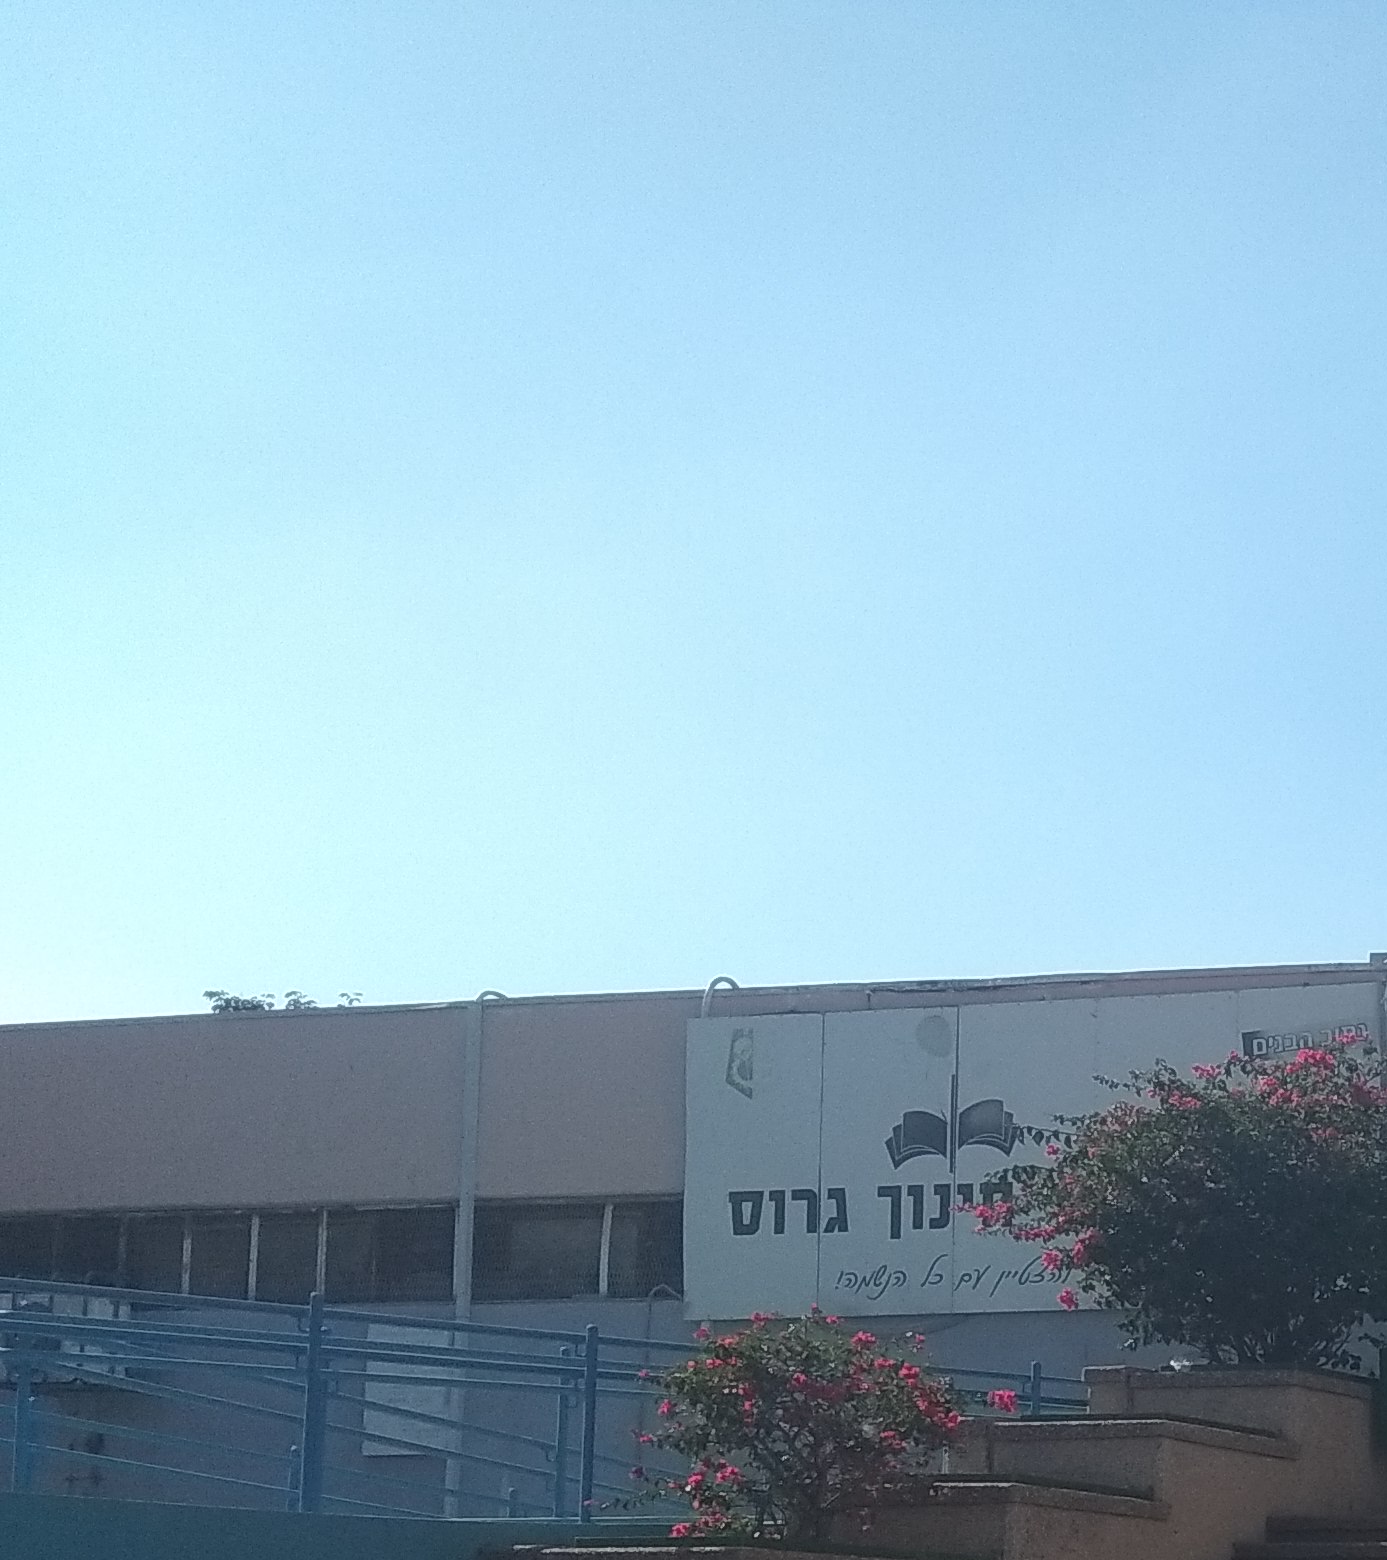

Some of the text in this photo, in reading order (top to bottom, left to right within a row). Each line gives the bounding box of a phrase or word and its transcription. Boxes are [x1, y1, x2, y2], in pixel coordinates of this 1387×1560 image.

[1252, 1031, 1313, 1057] הבנים
[728, 1182, 1013, 1239] חינוך גרוס
[834, 1264, 907, 1300] הנשמה!
[920, 1253, 949, 1288] כל
[953, 1264, 992, 1292] עם
